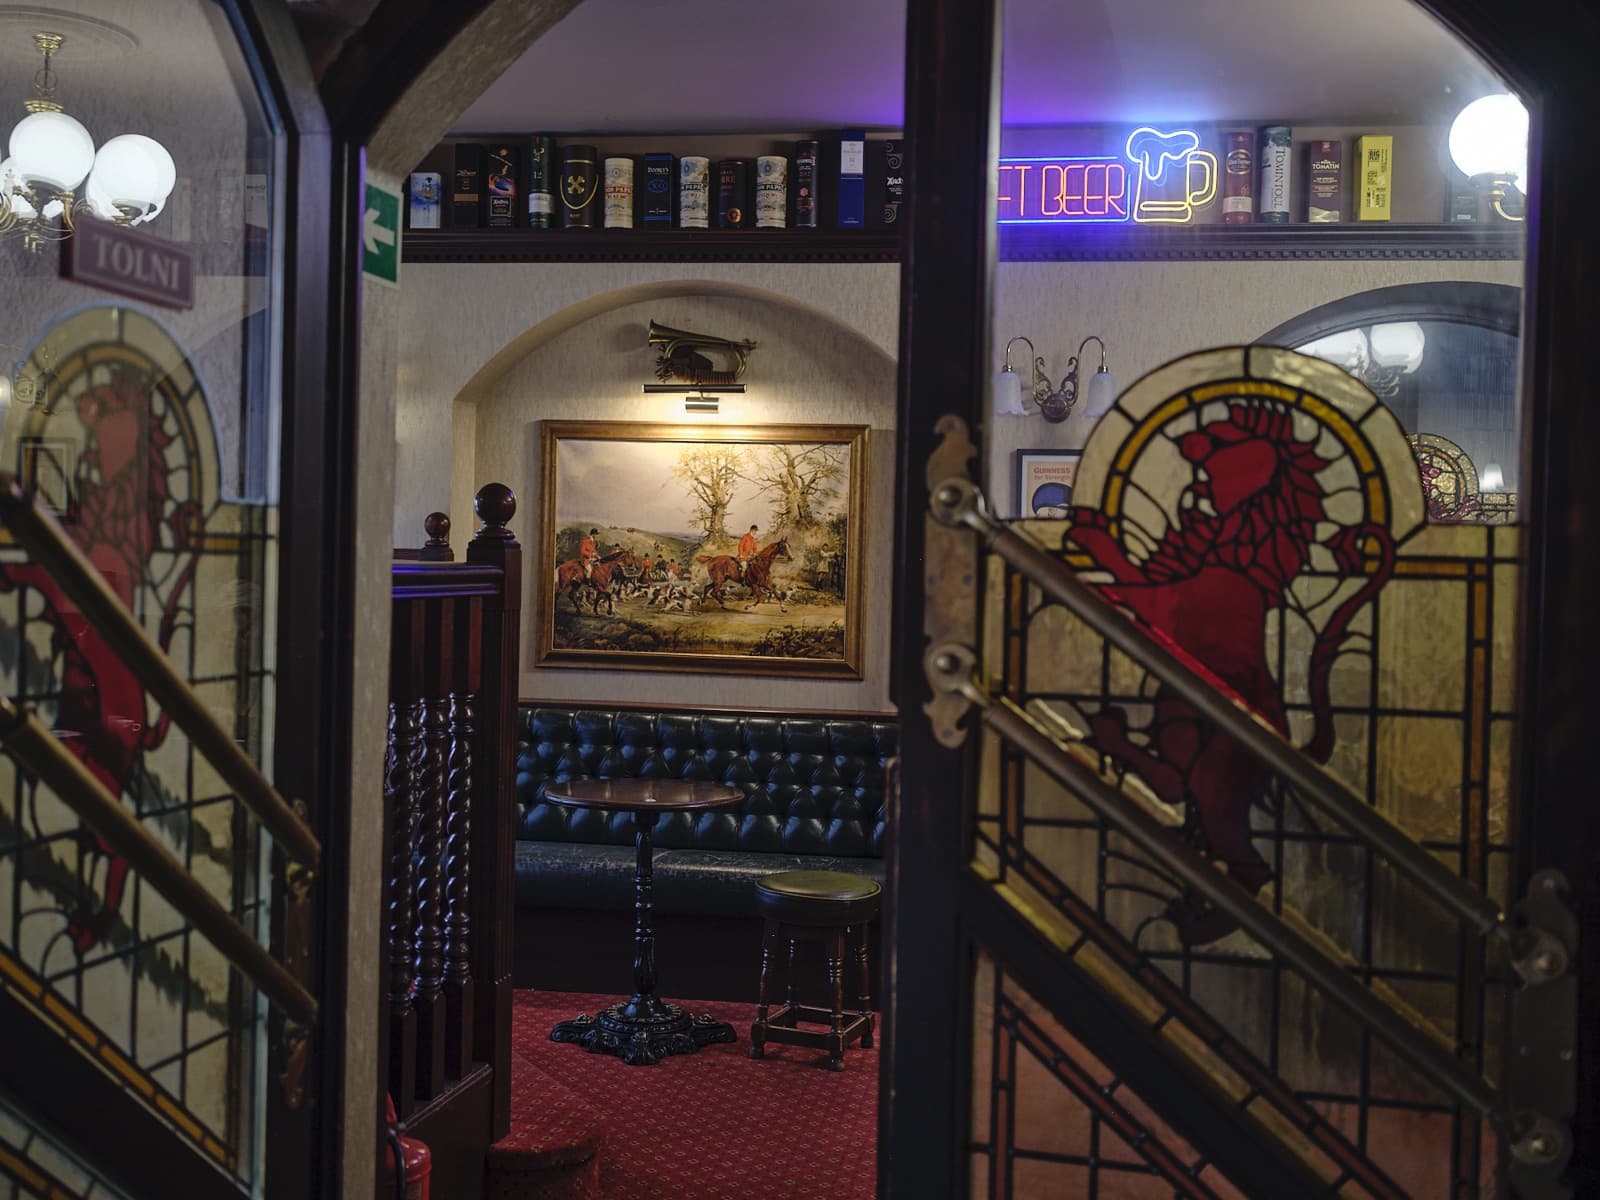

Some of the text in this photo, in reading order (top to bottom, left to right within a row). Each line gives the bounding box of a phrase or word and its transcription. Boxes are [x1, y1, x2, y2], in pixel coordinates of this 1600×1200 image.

[1042, 164, 1127, 216] BEER
[1274, 148, 1287, 208] TOMINTOUL
[93, 232, 180, 290] TOLNI
[1033, 466, 1071, 474] GUINNESS
